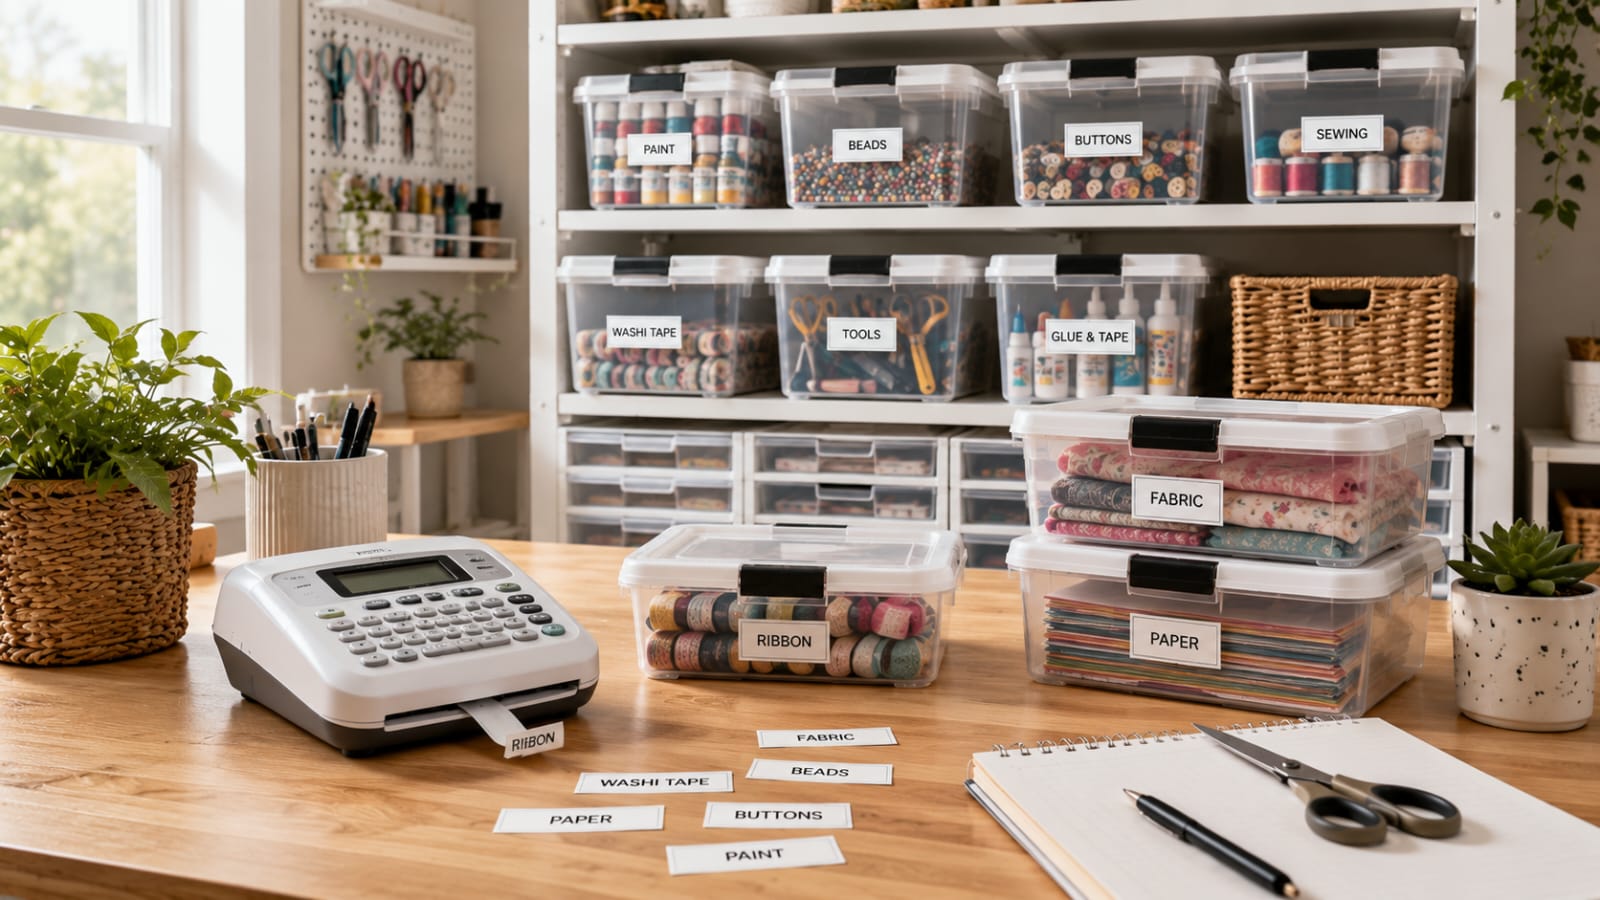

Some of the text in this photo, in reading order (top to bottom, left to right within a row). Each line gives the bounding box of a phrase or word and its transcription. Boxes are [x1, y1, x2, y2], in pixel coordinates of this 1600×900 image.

[1316, 127, 1368, 140] SEWING
[848, 139, 887, 151] BEADS
[1074, 133, 1132, 146] BUTTONS
[643, 143, 675, 154] PAINT
[612, 327, 677, 338] WASHI TAPE
[842, 328, 881, 340] TOOLS
[1051, 331, 1129, 342] GLUE & TAPE
[1150, 491, 1204, 508] FABRIC
[757, 634, 812, 648] RIBBON
[1150, 631, 1199, 651] PAPER
[796, 733, 855, 743] FABRIC
[791, 766, 849, 777] BEADS
[600, 777, 710, 787] WASHI TAPE
[549, 814, 612, 825] PAPER
[735, 810, 823, 820] BUTTONS
[725, 848, 784, 862] PAINT
